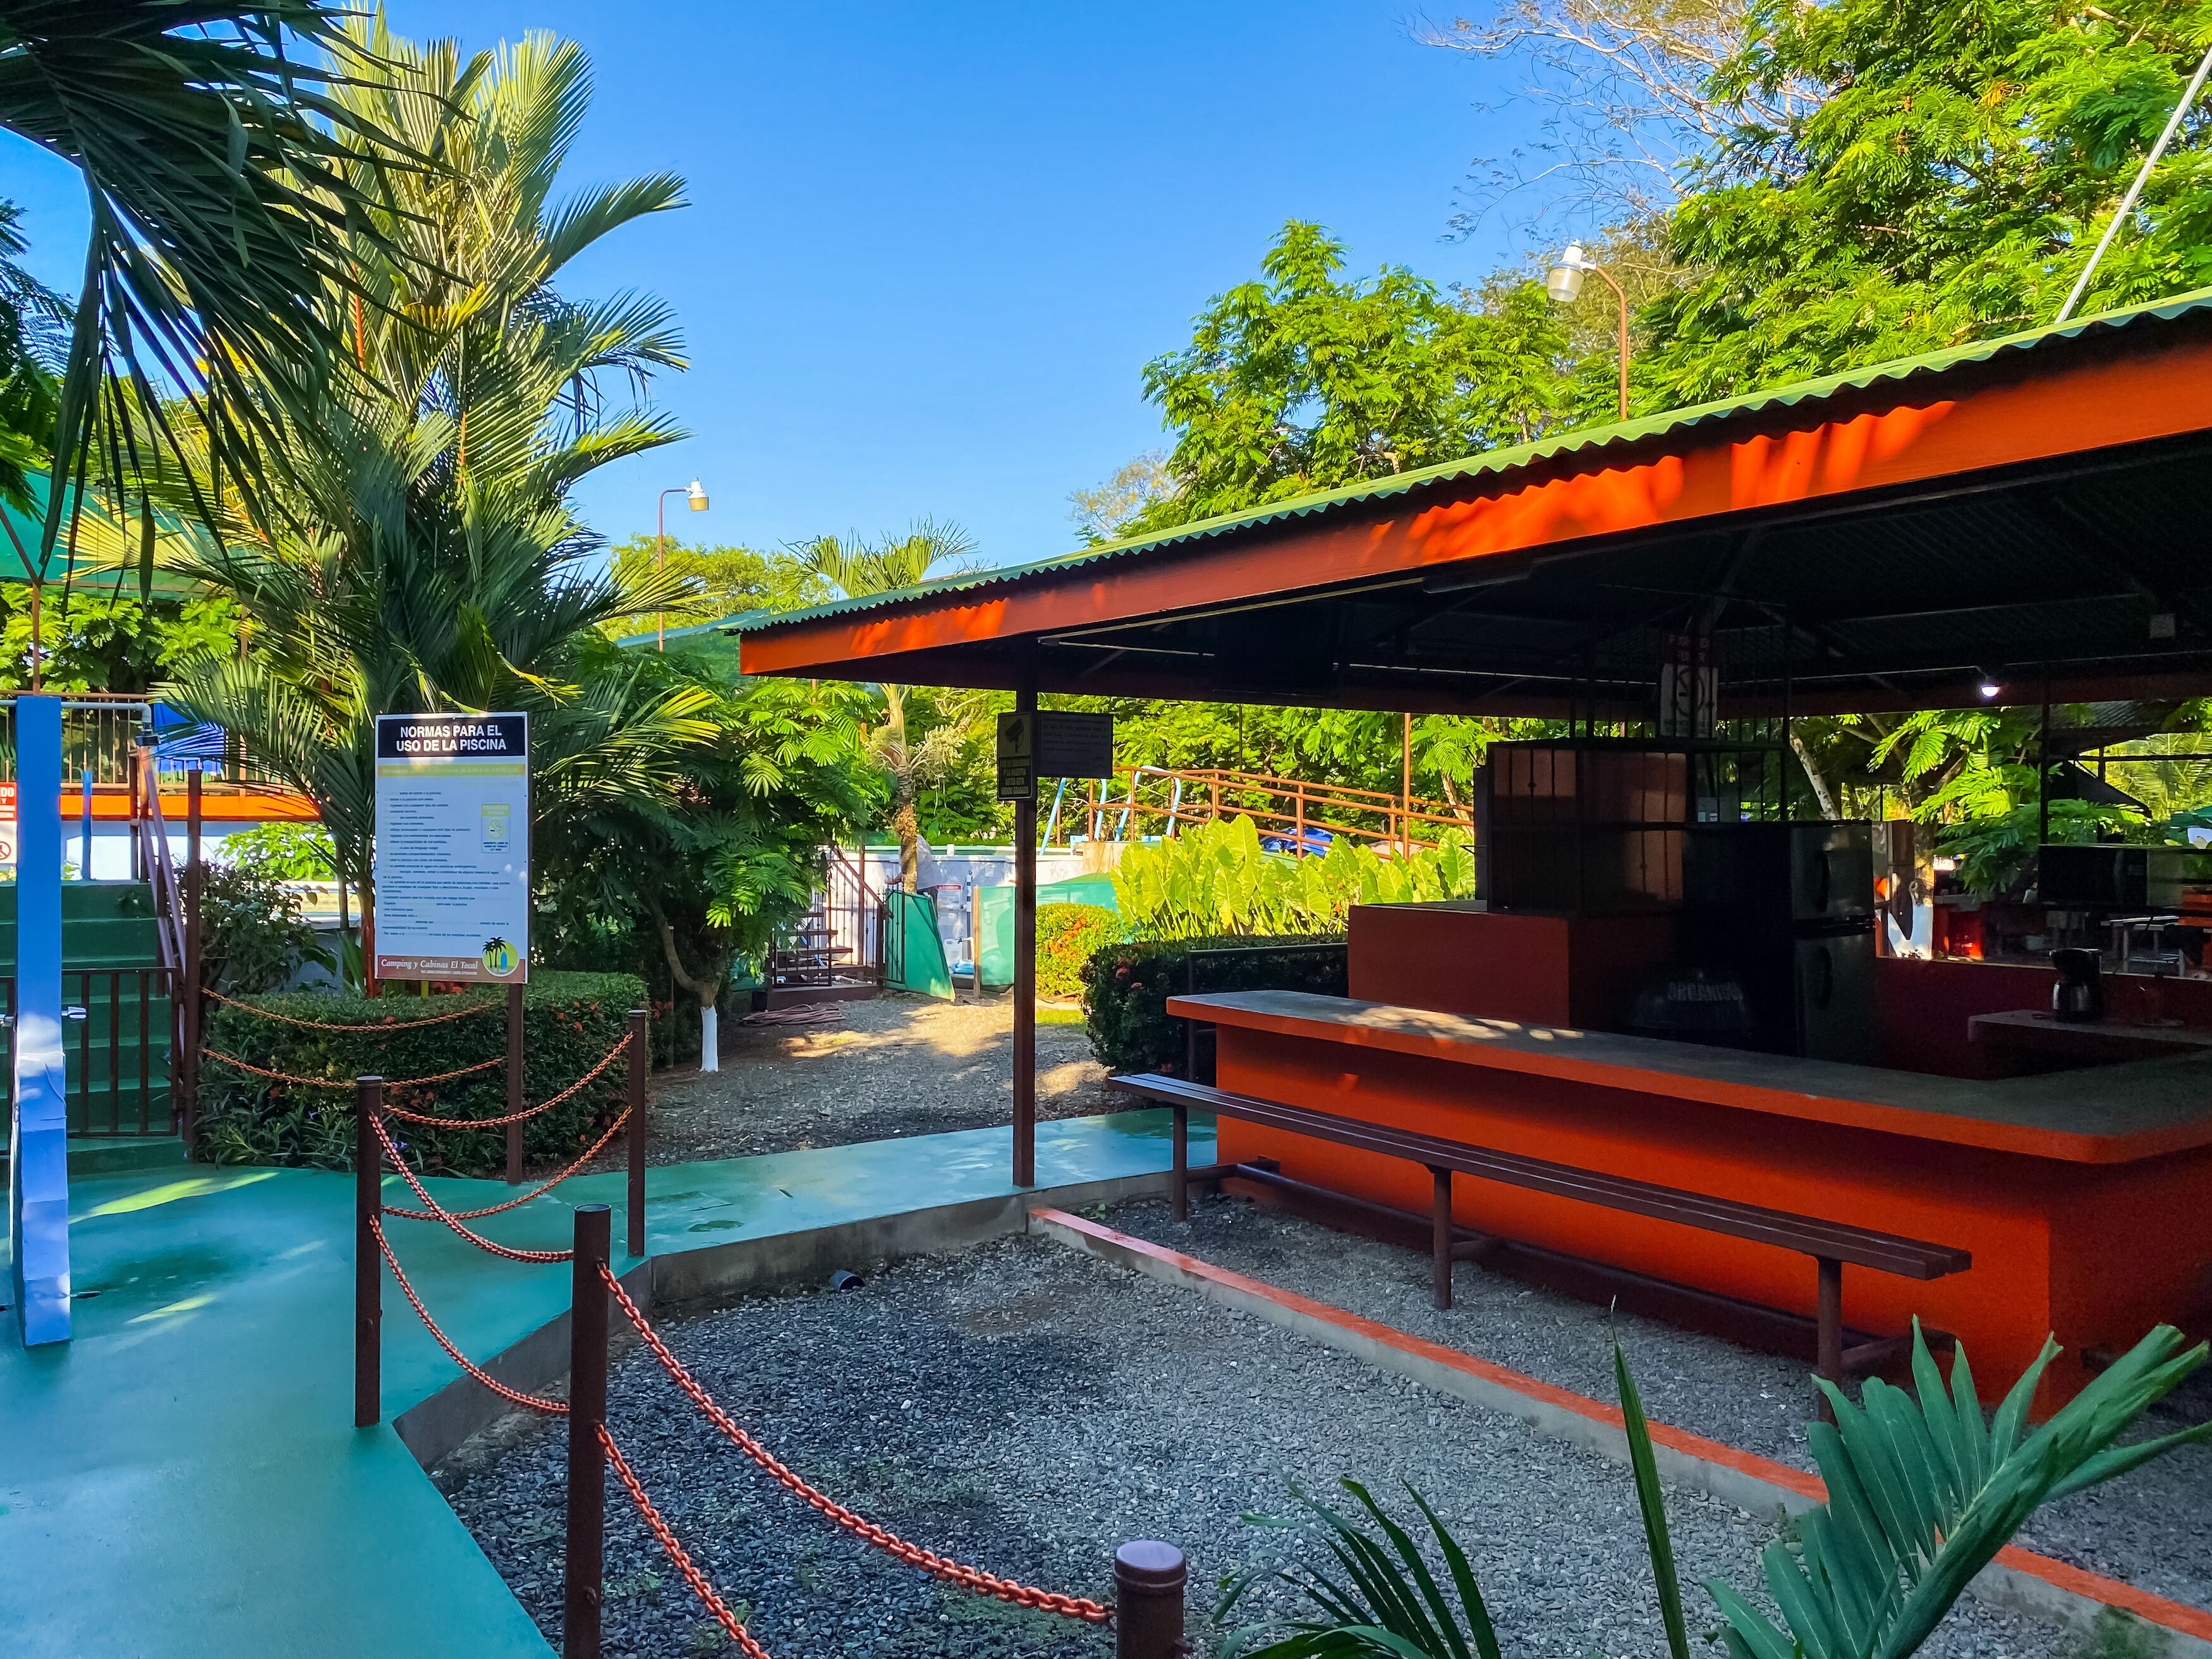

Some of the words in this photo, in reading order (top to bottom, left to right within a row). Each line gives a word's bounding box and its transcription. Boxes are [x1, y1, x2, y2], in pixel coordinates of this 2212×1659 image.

[401, 725, 451, 738] NORMAS
[453, 725, 484, 737] PARA
[487, 724, 502, 736] EL
[396, 739, 421, 752] USO
[423, 739, 439, 751] DE
[441, 739, 458, 751] LA
[459, 739, 506, 751] PISCINA
[0, 787, 15, 798] DO
[381, 959, 412, 970] Camping
[420, 960, 449, 969] Cabinas
[451, 960, 458, 969] El
[461, 961, 478, 969] Tecal
